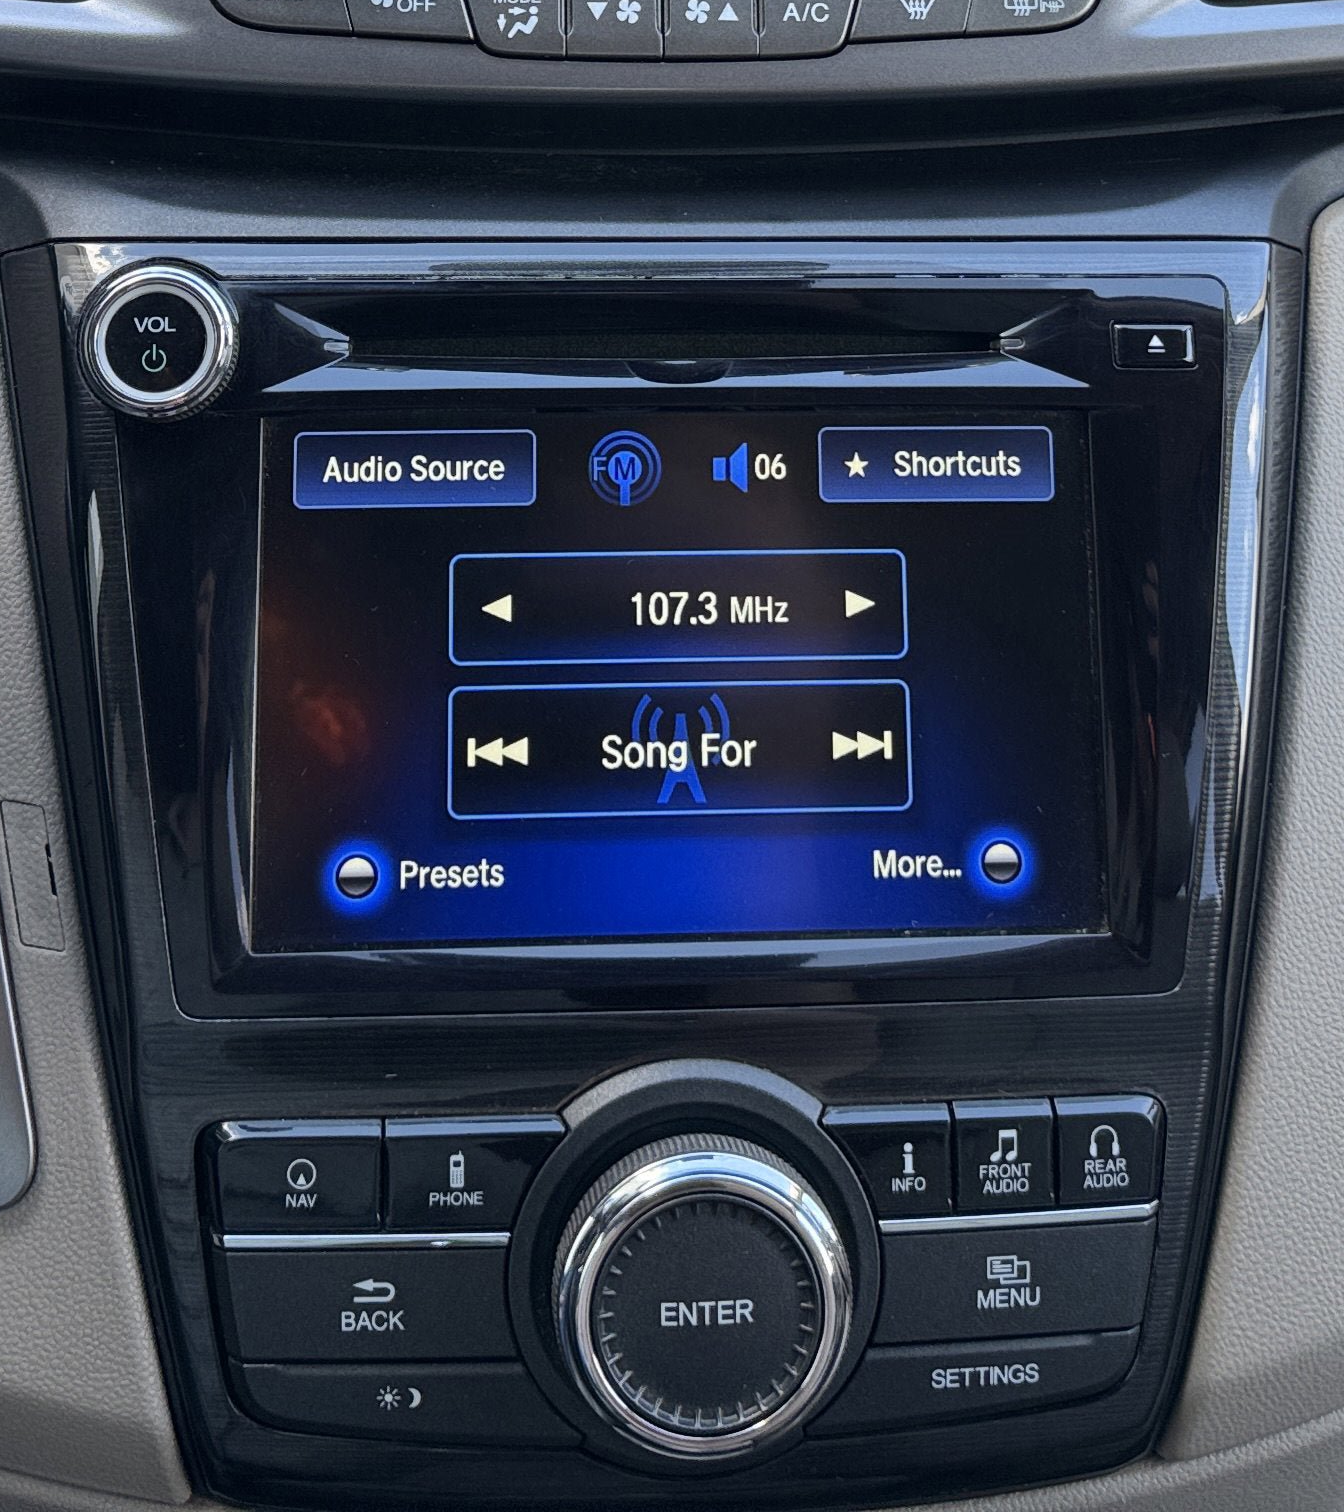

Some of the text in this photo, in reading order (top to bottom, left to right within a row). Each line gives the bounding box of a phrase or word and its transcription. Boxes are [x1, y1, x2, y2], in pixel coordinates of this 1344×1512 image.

[782, 2, 830, 23] A/C
[133, 316, 177, 333] VOL
[322, 454, 506, 483] Audio Source
[591, 455, 636, 483] FM
[754, 453, 787, 480] 06
[893, 450, 1022, 478] Shortcuts
[631, 591, 789, 626] 107.3 MHz
[601, 732, 757, 773] Song For
[399, 858, 505, 889] Presets
[872, 848, 963, 879] More...
[979, 1162, 1032, 1179] FRONT
[1083, 1157, 1127, 1174] REAR
[891, 1176, 927, 1192] INFO
[982, 1178, 1030, 1194] AUDIO
[1083, 1172, 1130, 1189] AUDIO
[285, 1193, 318, 1208] NAV
[428, 1190, 484, 1206] PHONE
[976, 1286, 1041, 1310] MENU
[340, 1310, 406, 1332] BACK
[659, 1299, 754, 1327] ENTER
[931, 1363, 1040, 1389] SETTINGS
